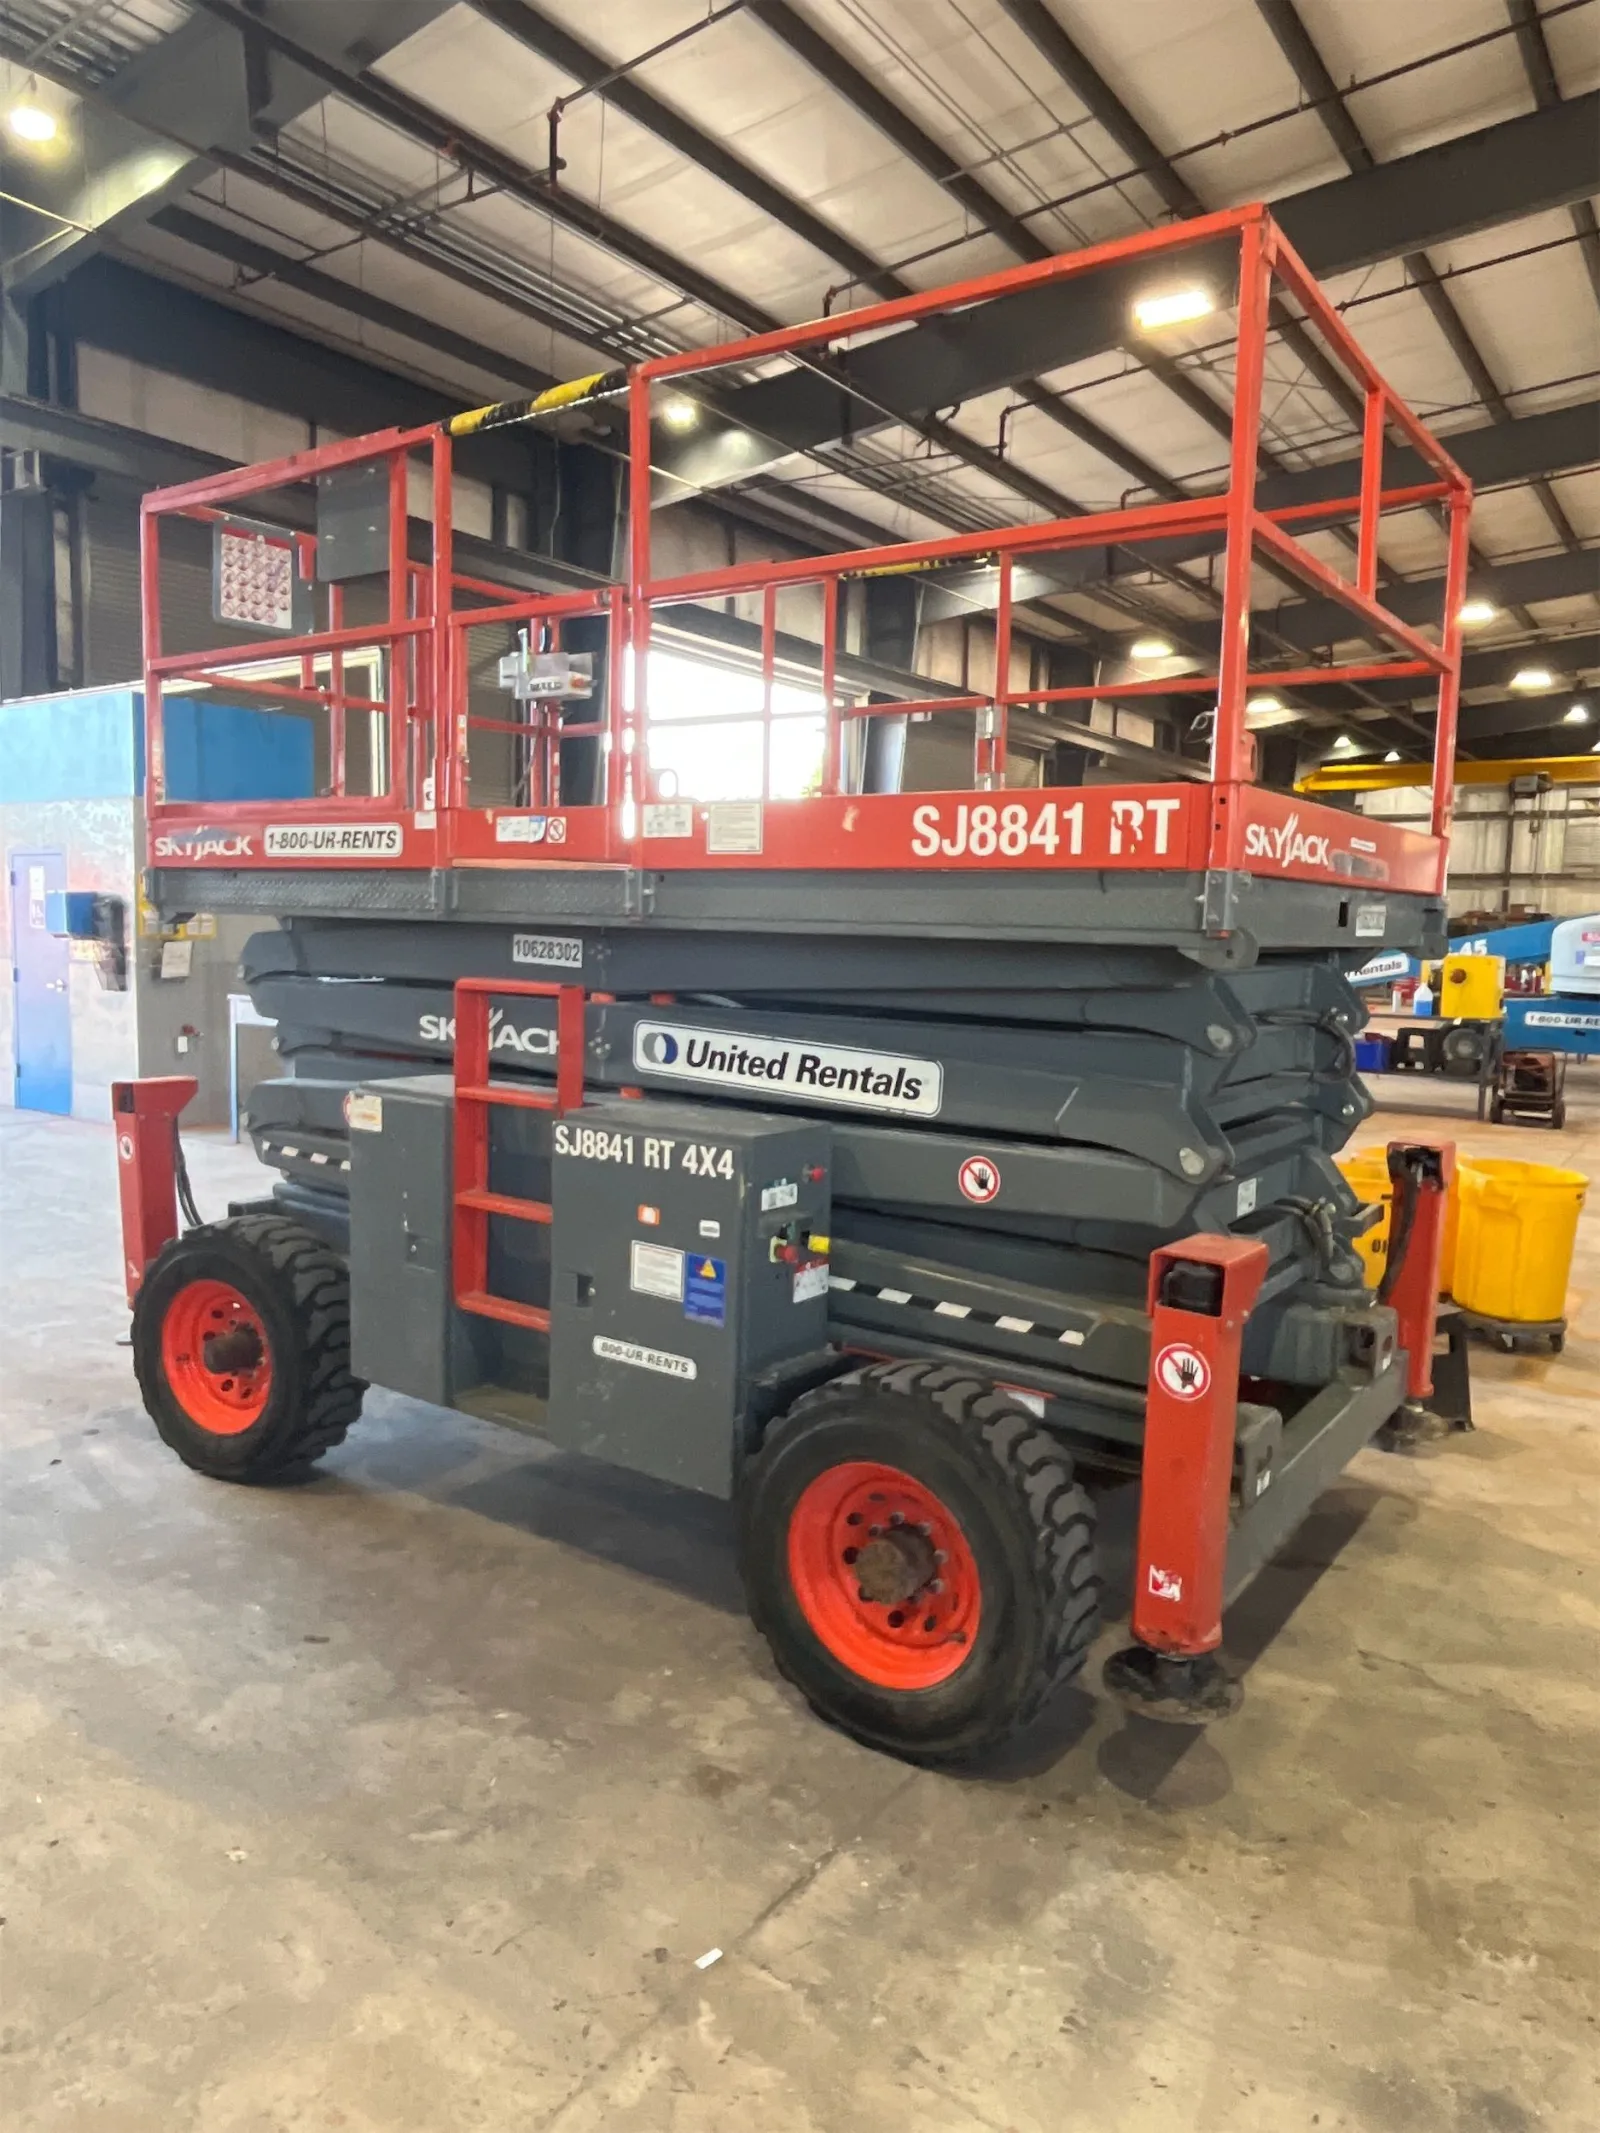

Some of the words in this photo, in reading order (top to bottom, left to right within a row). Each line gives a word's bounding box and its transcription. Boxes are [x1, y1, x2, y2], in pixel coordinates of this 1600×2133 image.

[268, 830, 397, 850] 1-800-UR-RENTS
[911, 802, 1083, 857] SJ8841
[1109, 799, 1181, 855] RT
[1244, 812, 1330, 868] SKYJACK
[514, 939, 580, 962] 10628302
[686, 1038, 790, 1081] United
[796, 1054, 923, 1100] Rentals
[555, 1124, 634, 1165] SJ8841
[644, 1137, 675, 1171] RT
[682, 1144, 735, 1180] 4X4
